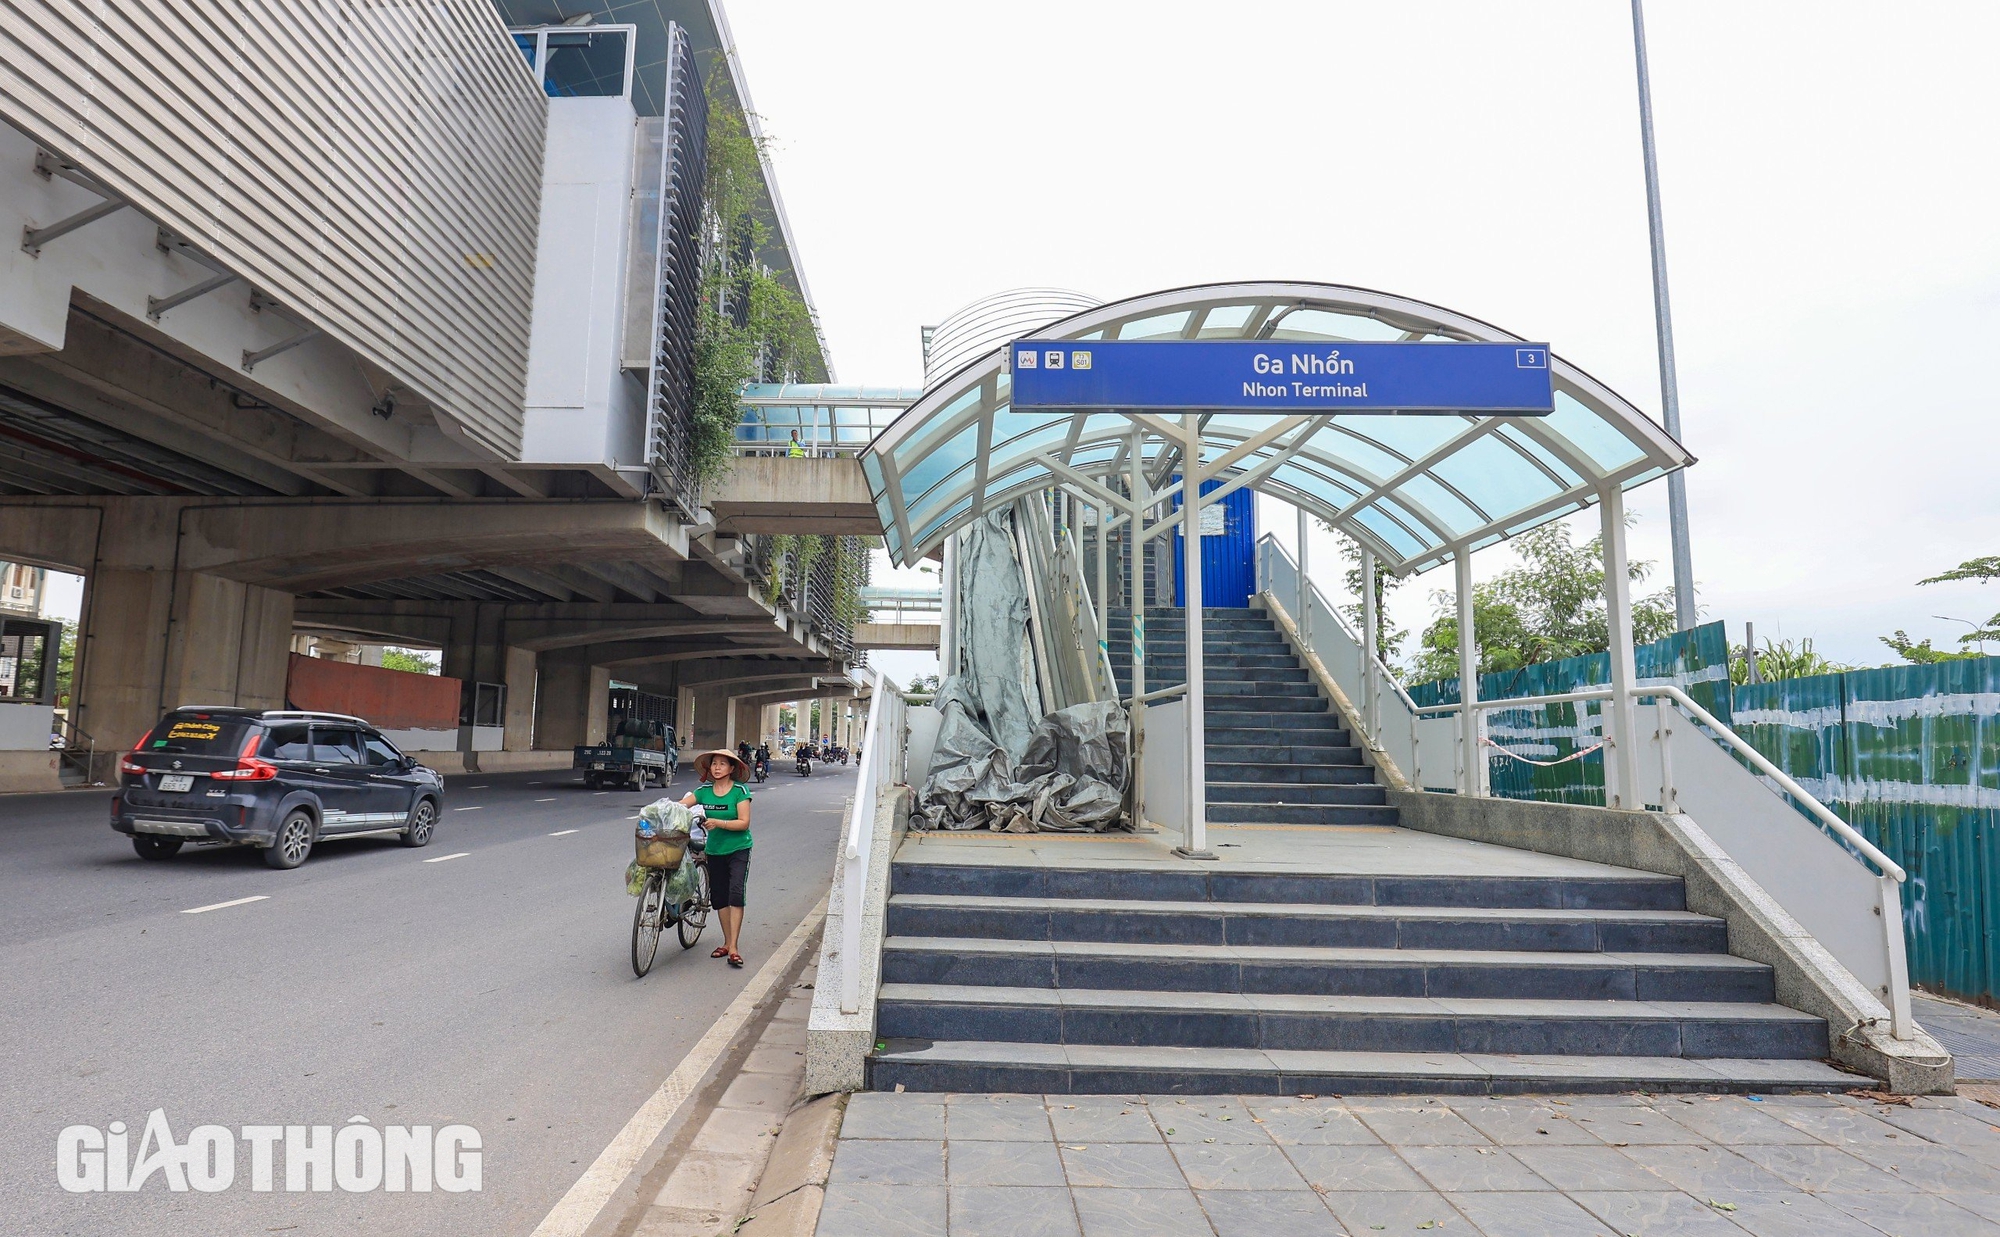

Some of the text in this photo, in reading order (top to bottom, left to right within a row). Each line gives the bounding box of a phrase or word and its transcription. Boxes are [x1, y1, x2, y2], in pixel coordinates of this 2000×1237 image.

[1253, 350, 1354, 375] Ga Nhổn
[1527, 353, 1535, 364] 3
[1243, 382, 1368, 397] Nhon Terminal
